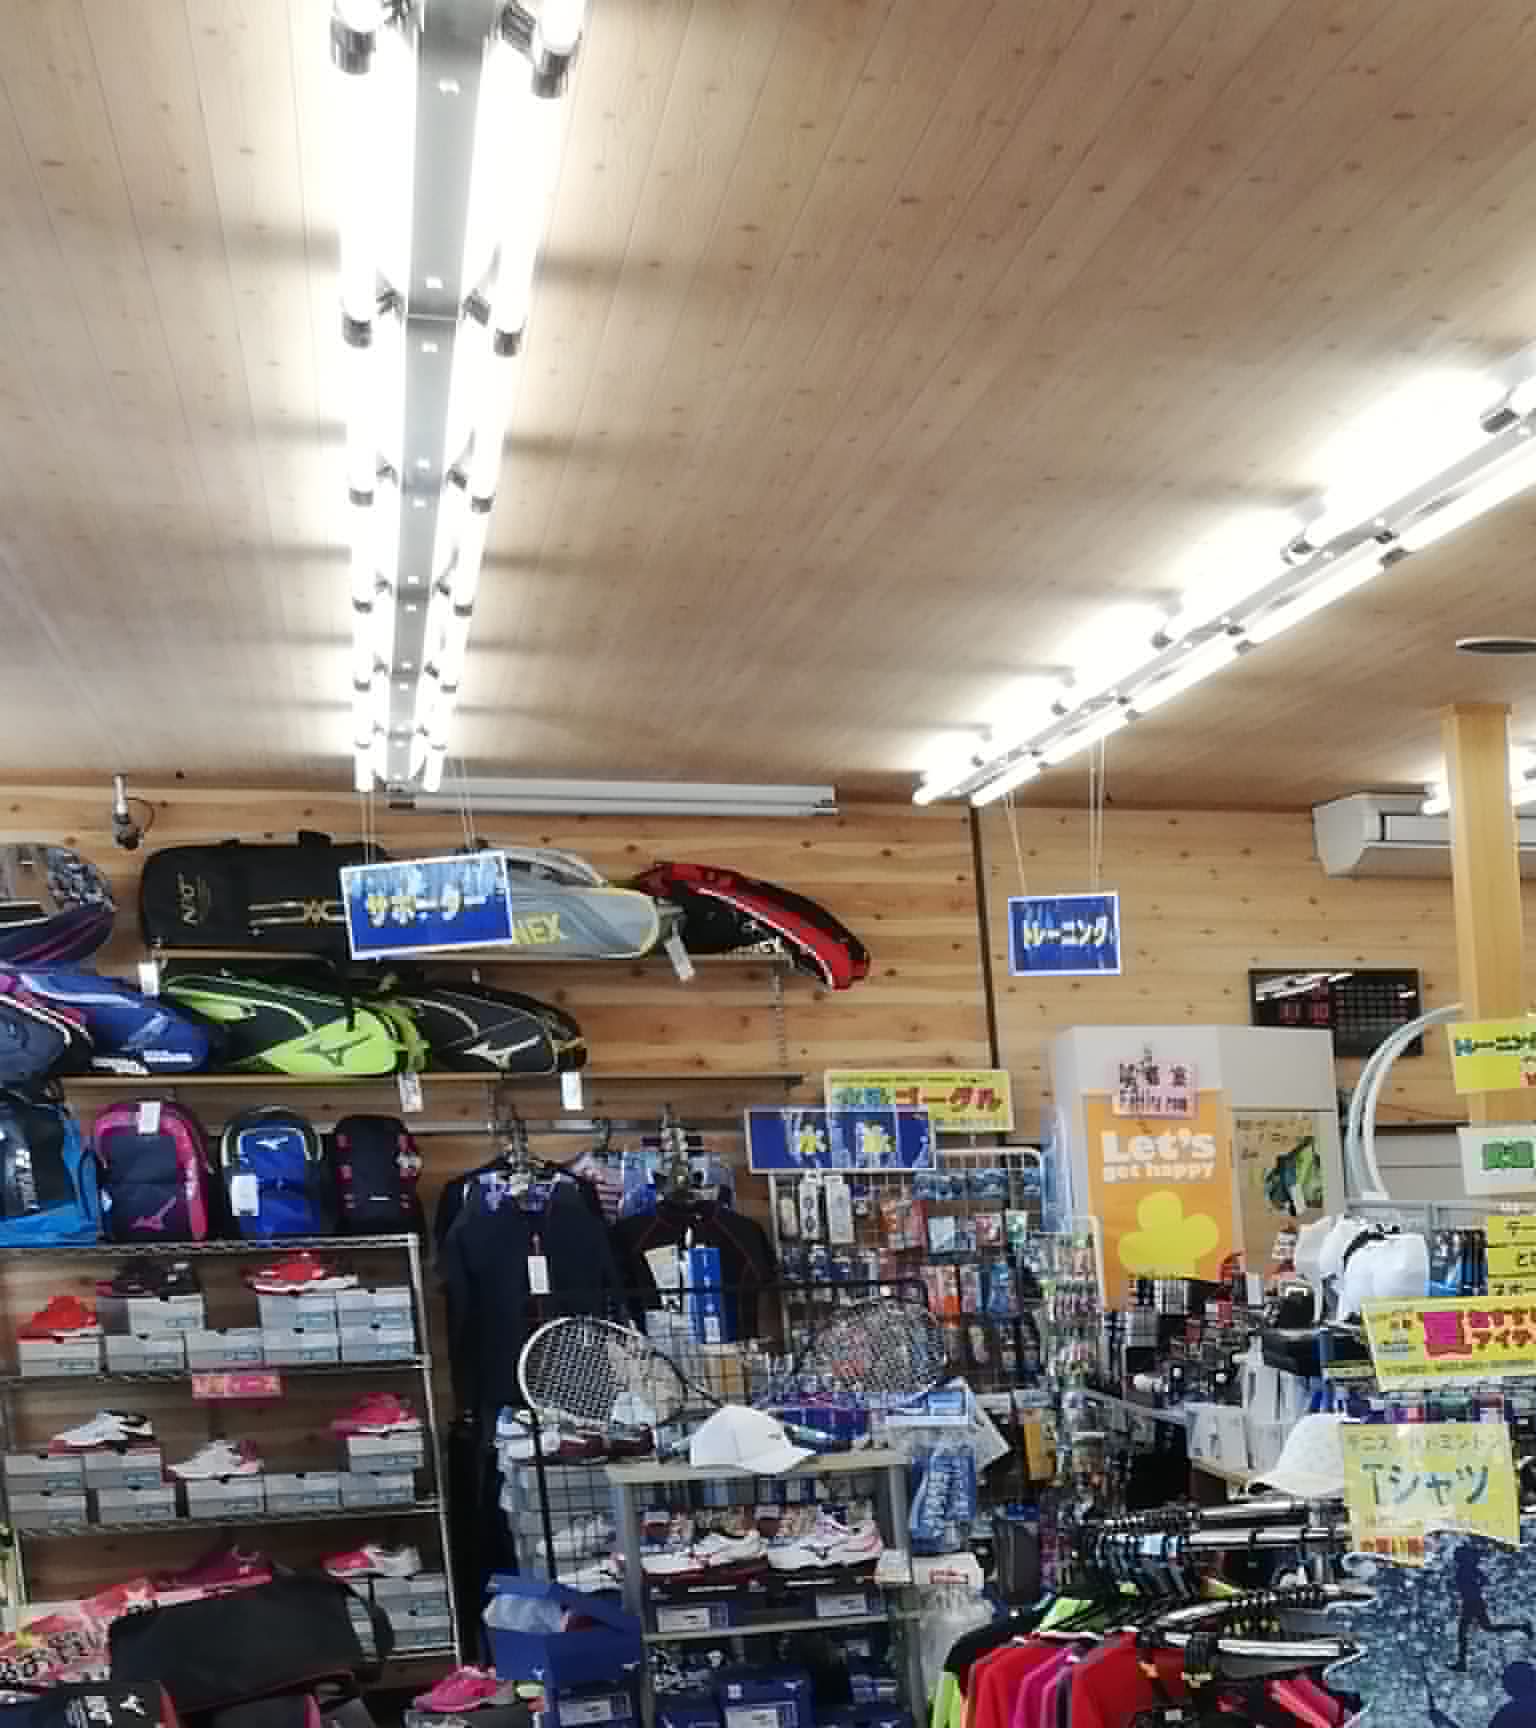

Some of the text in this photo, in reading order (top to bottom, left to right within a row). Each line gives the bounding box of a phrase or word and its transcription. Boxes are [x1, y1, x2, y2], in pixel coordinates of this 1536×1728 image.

[511, 911, 562, 945] NEX
[1101, 1128, 1216, 1163] Let's
[1102, 1160, 1216, 1184] get happy
[1361, 1462, 1489, 1506] Tシャツ
